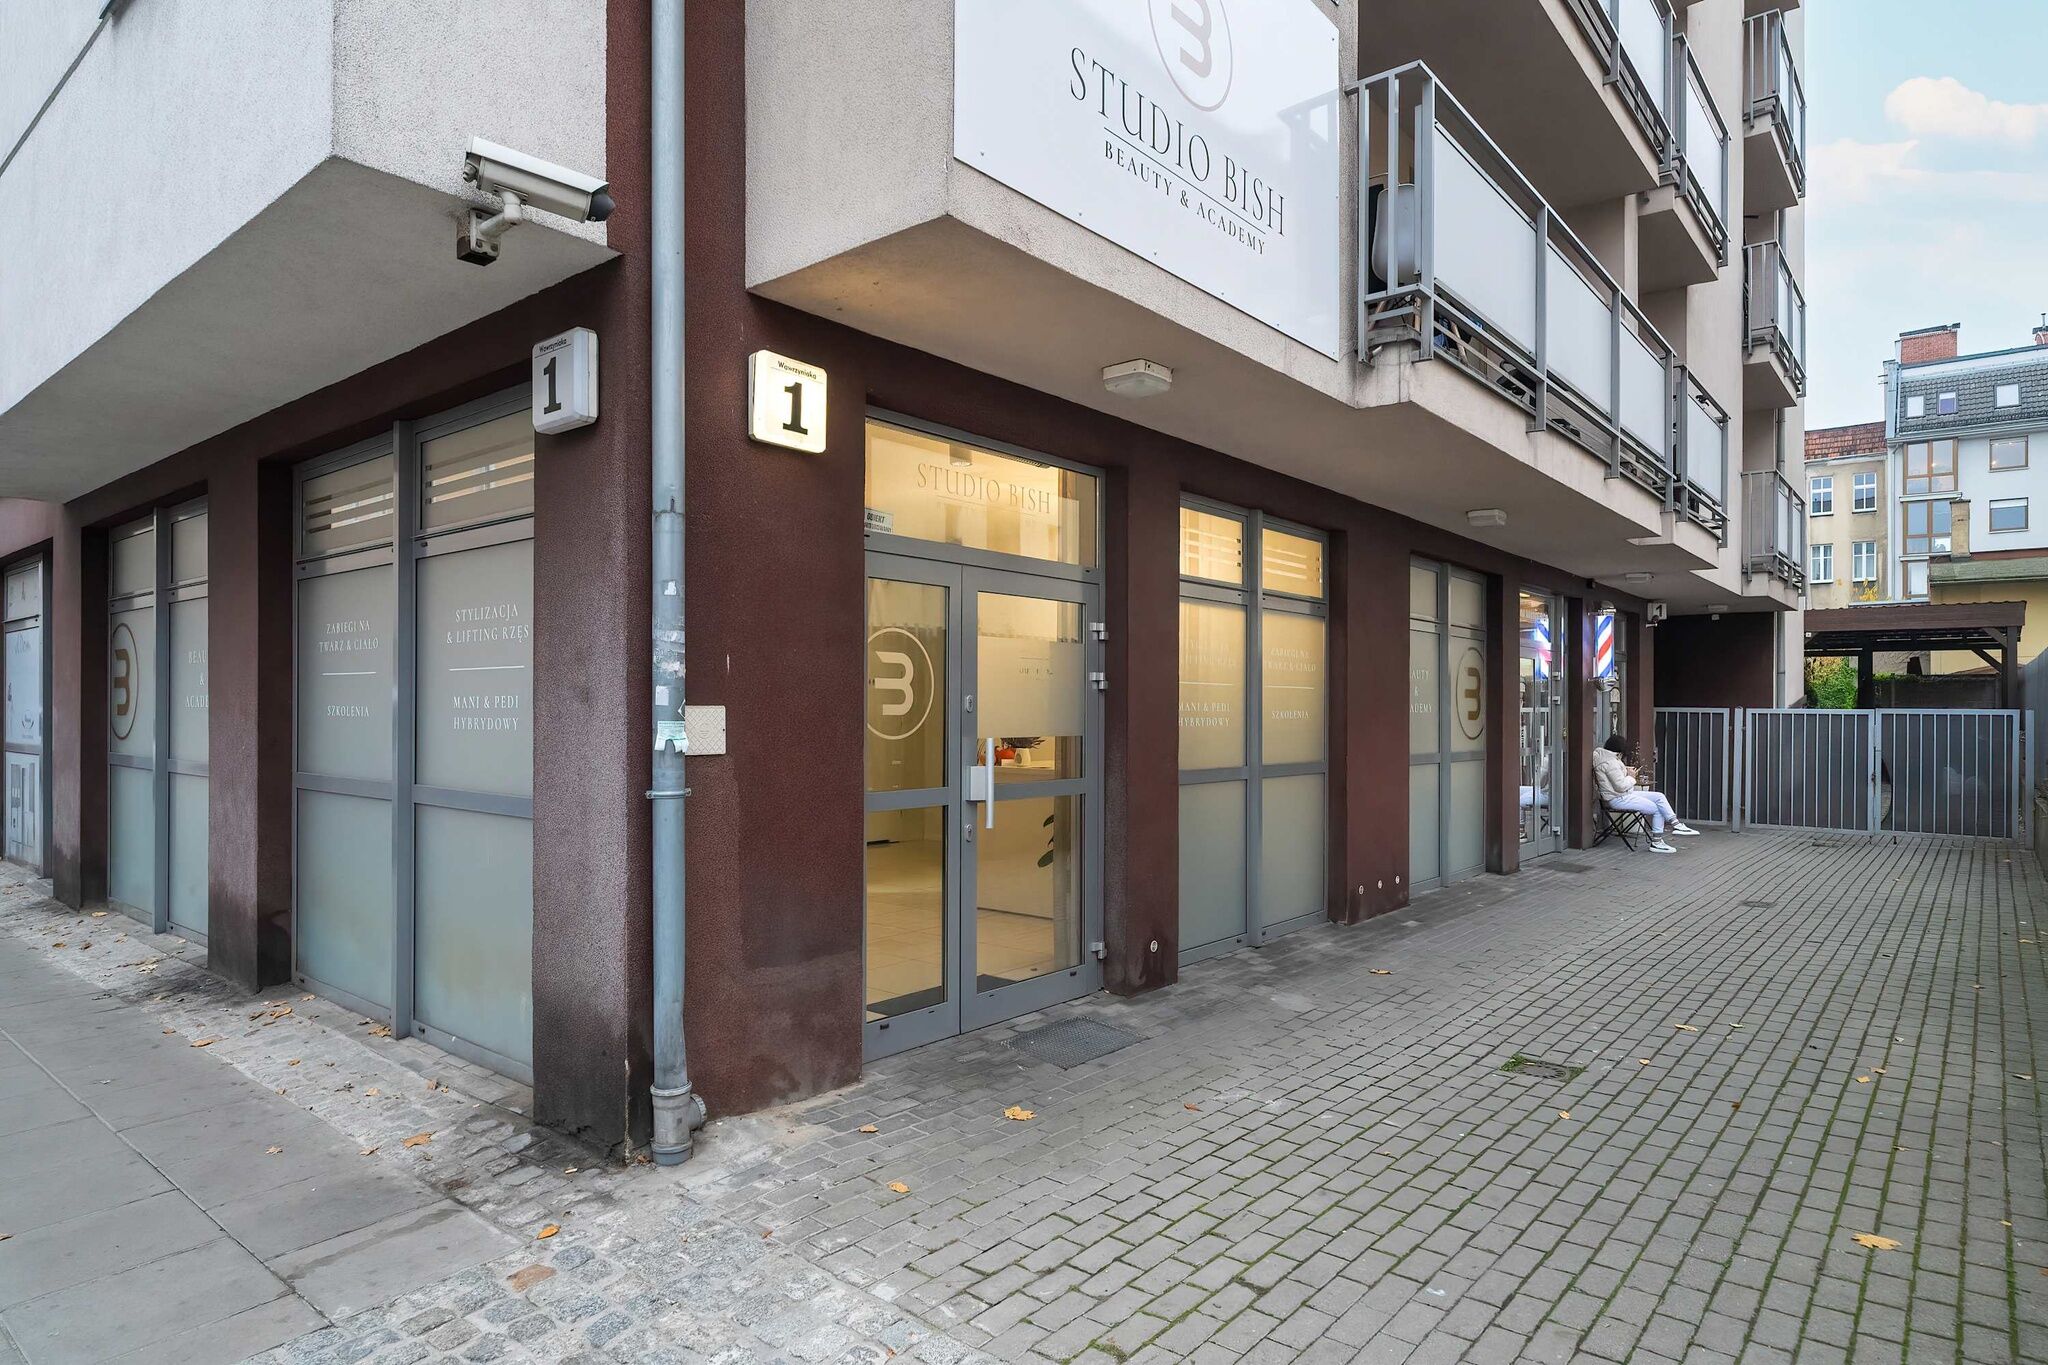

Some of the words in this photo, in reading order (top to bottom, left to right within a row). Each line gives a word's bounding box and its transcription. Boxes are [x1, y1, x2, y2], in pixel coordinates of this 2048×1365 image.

[1070, 47, 1210, 182] STUDIO
[1223, 154, 1285, 237] BISH
[1104, 140, 1172, 196] BEAUTY
[1180, 189, 1190, 209] &
[1196, 201, 1265, 255] ACADEMY
[777, 360, 817, 380] Wawrzyniaka
[543, 356, 562, 415] 1
[782, 381, 809, 436] 1
[917, 462, 1001, 503] STUDIO
[1009, 483, 1051, 514] BISH
[455, 603, 518, 623] STYLIZACJA
[446, 631, 453, 644] &
[456, 627, 498, 643] LIFTING
[502, 624, 529, 643] RZĘS
[327, 704, 370, 717] SZKOLENIA
[453, 696, 479, 709] MANI
[483, 695, 491, 709] &
[494, 695, 519, 709] PEDI
[453, 716, 519, 731] HYBRYDOWY
